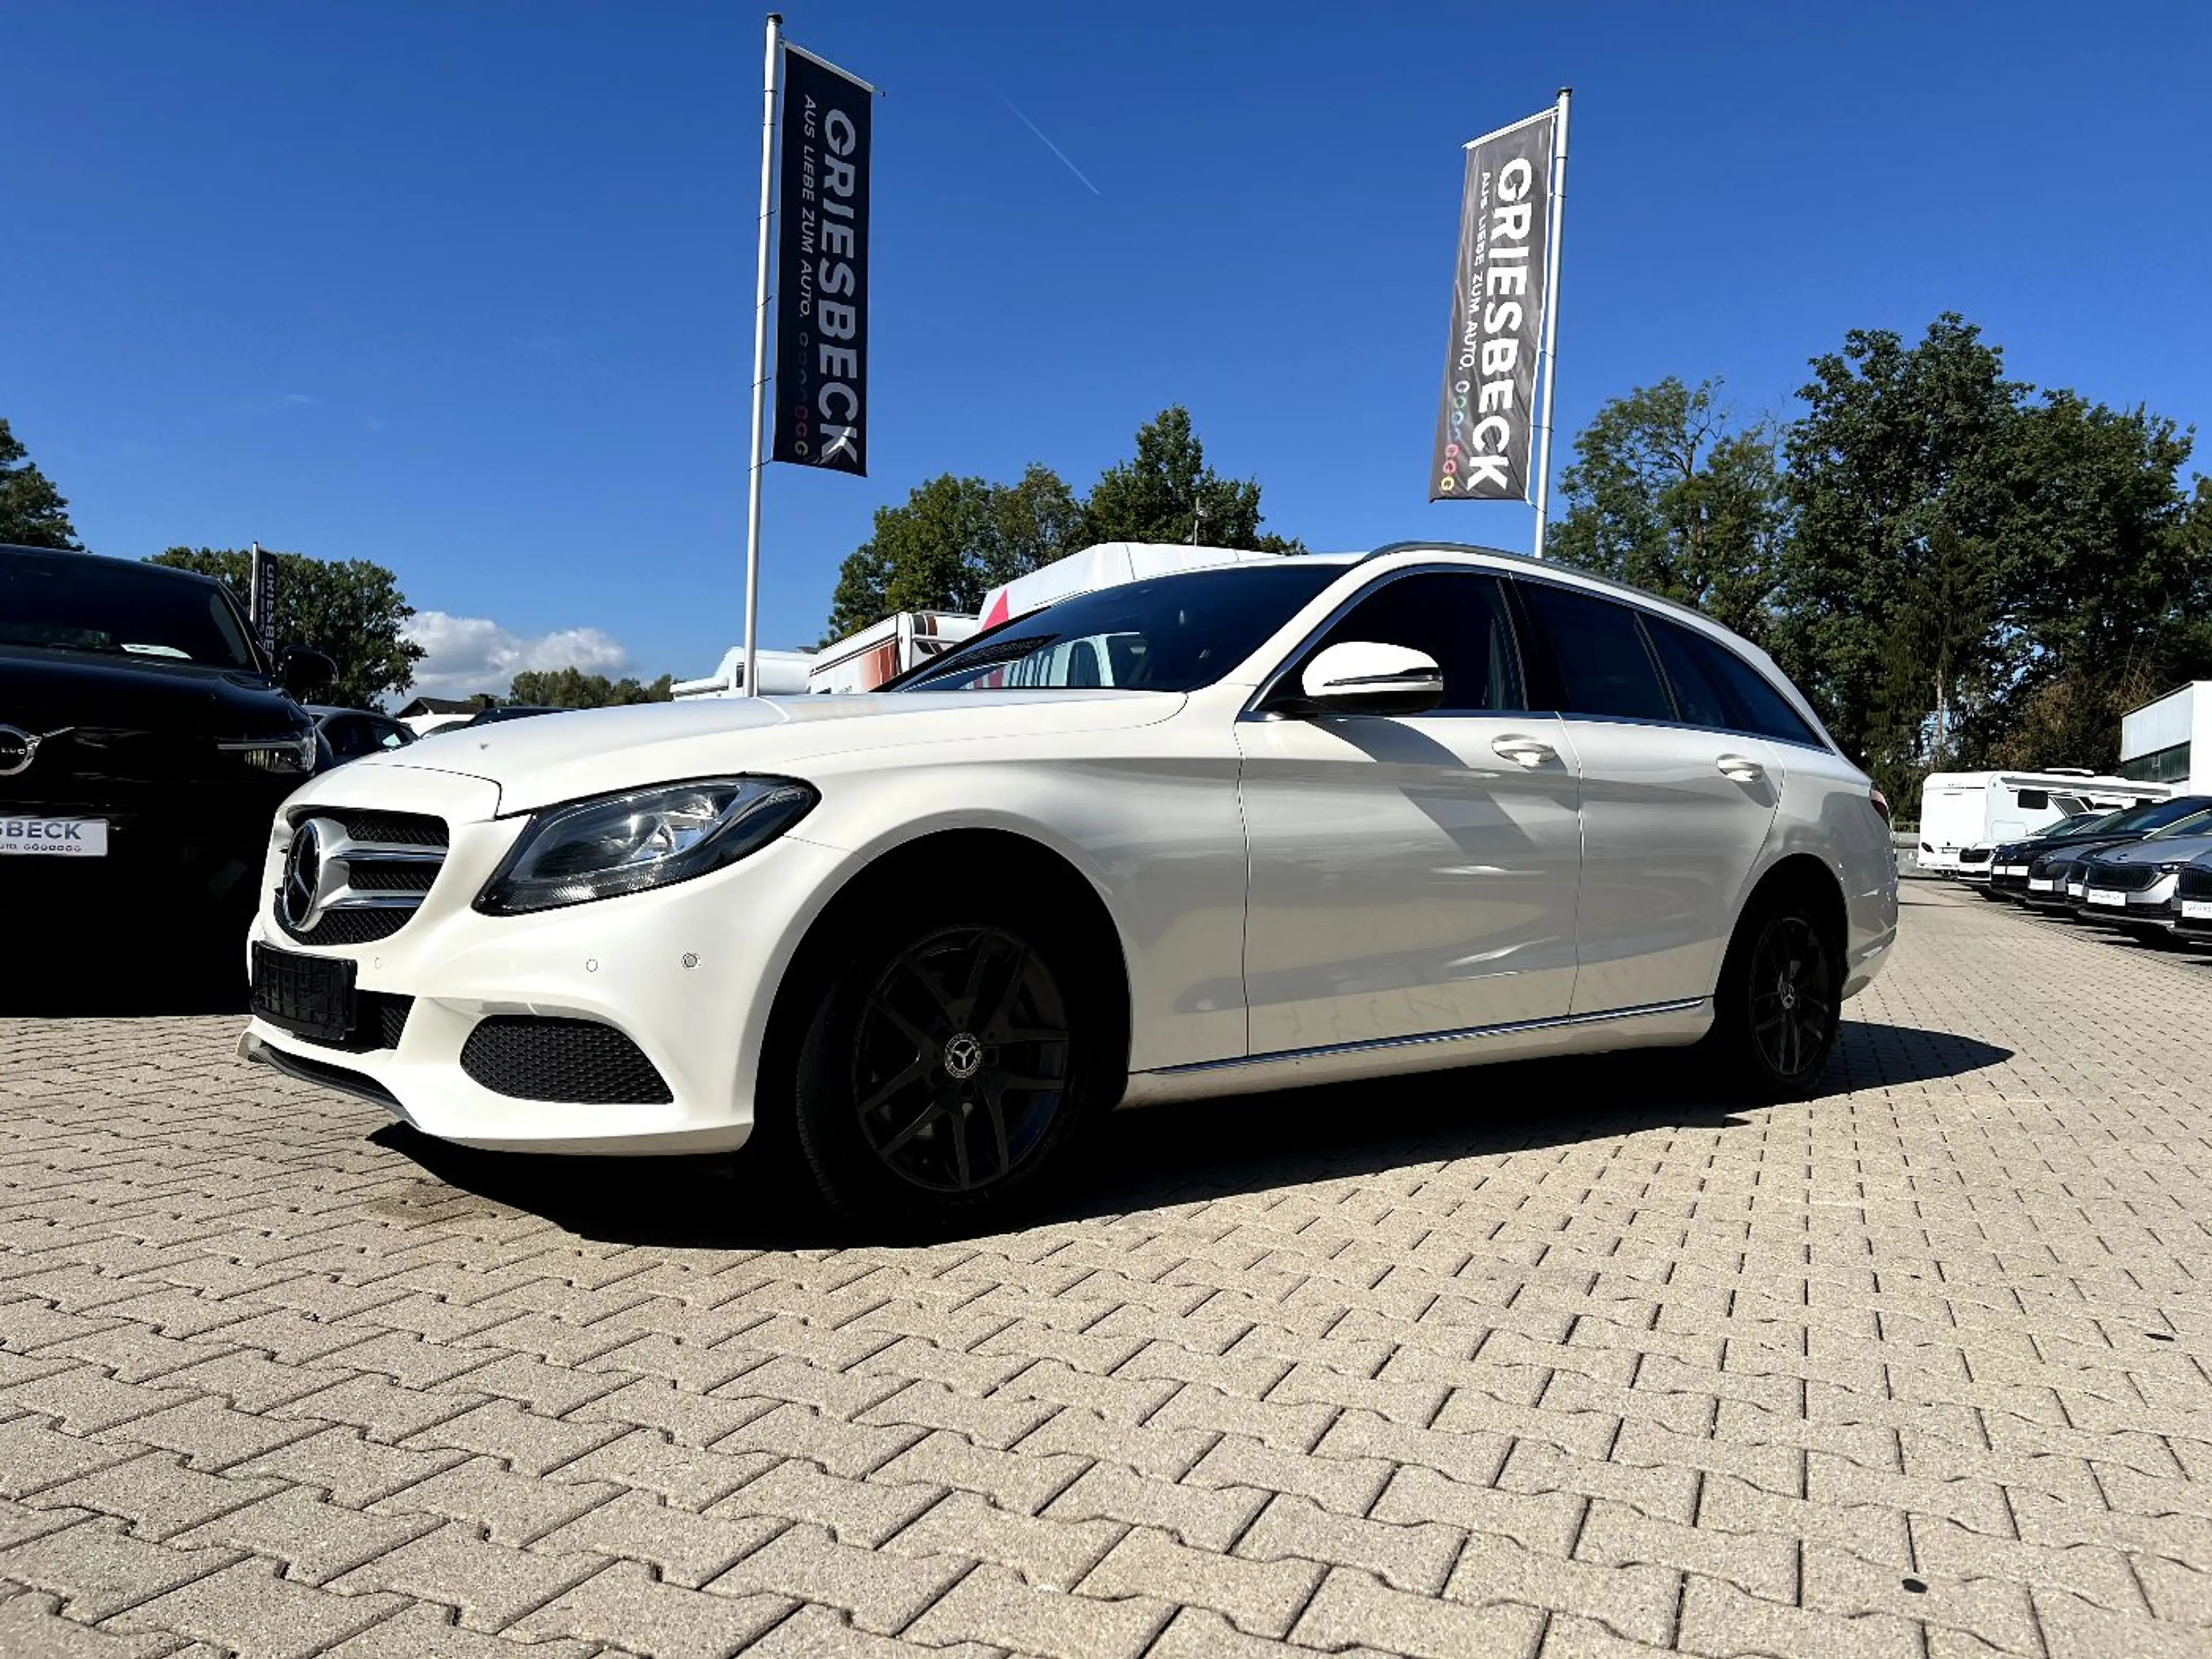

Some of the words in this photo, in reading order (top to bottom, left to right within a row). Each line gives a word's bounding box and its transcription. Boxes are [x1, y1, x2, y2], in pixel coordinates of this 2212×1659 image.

[804, 94, 816, 138] AUS
[802, 145, 815, 202] LIEBE
[801, 207, 815, 254] ZUM
[1474, 215, 1487, 267] LIEBE
[800, 259, 812, 317] AUTO.
[818, 108, 859, 464] GRIESBECK
[1469, 271, 1483, 314] ZUM
[1459, 321, 1478, 370] AUTO.
[1467, 157, 1532, 491] GRIESBECK
